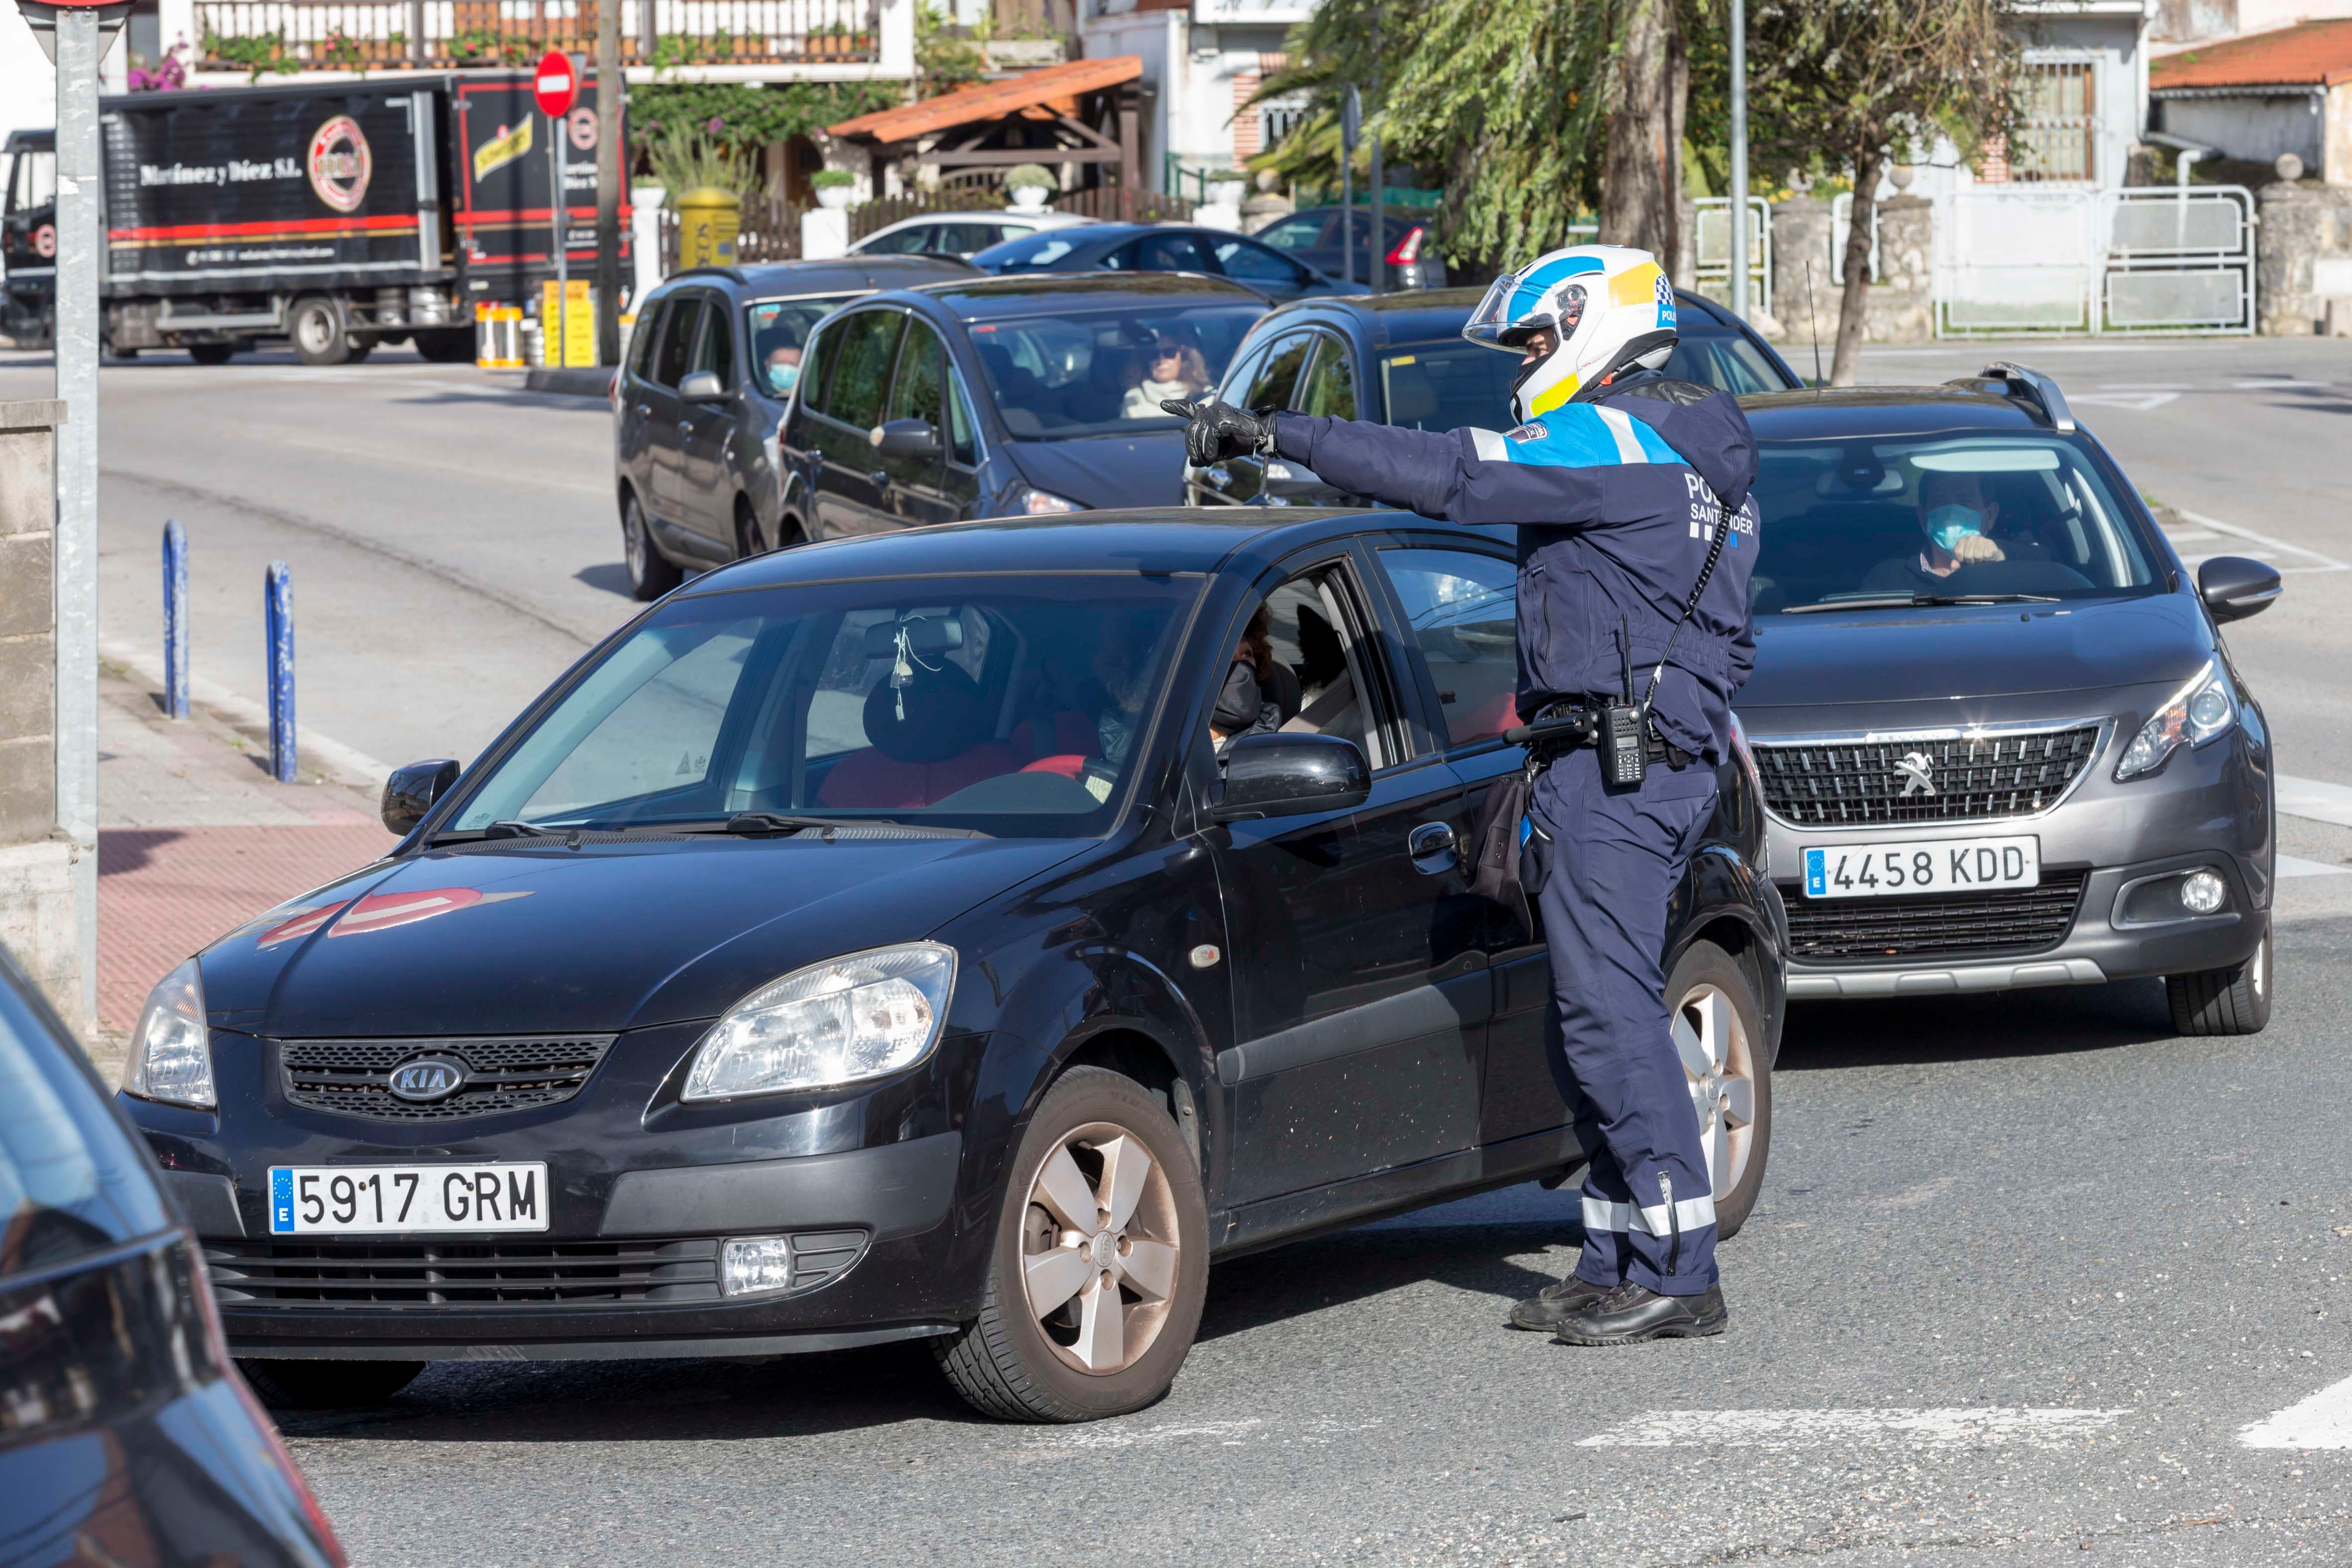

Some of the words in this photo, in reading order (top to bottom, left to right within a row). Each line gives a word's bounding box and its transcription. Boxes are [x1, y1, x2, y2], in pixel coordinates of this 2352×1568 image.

[1690, 503, 1753, 536] SANTNDER
[1812, 876, 1821, 888] E
[1834, 851, 1933, 890] 4458
[1950, 846, 2024, 884] KDD
[400, 1069, 446, 1088] KIA
[279, 1207, 289, 1221] E
[300, 1173, 420, 1224] 5917
[443, 1171, 537, 1221] GRM
